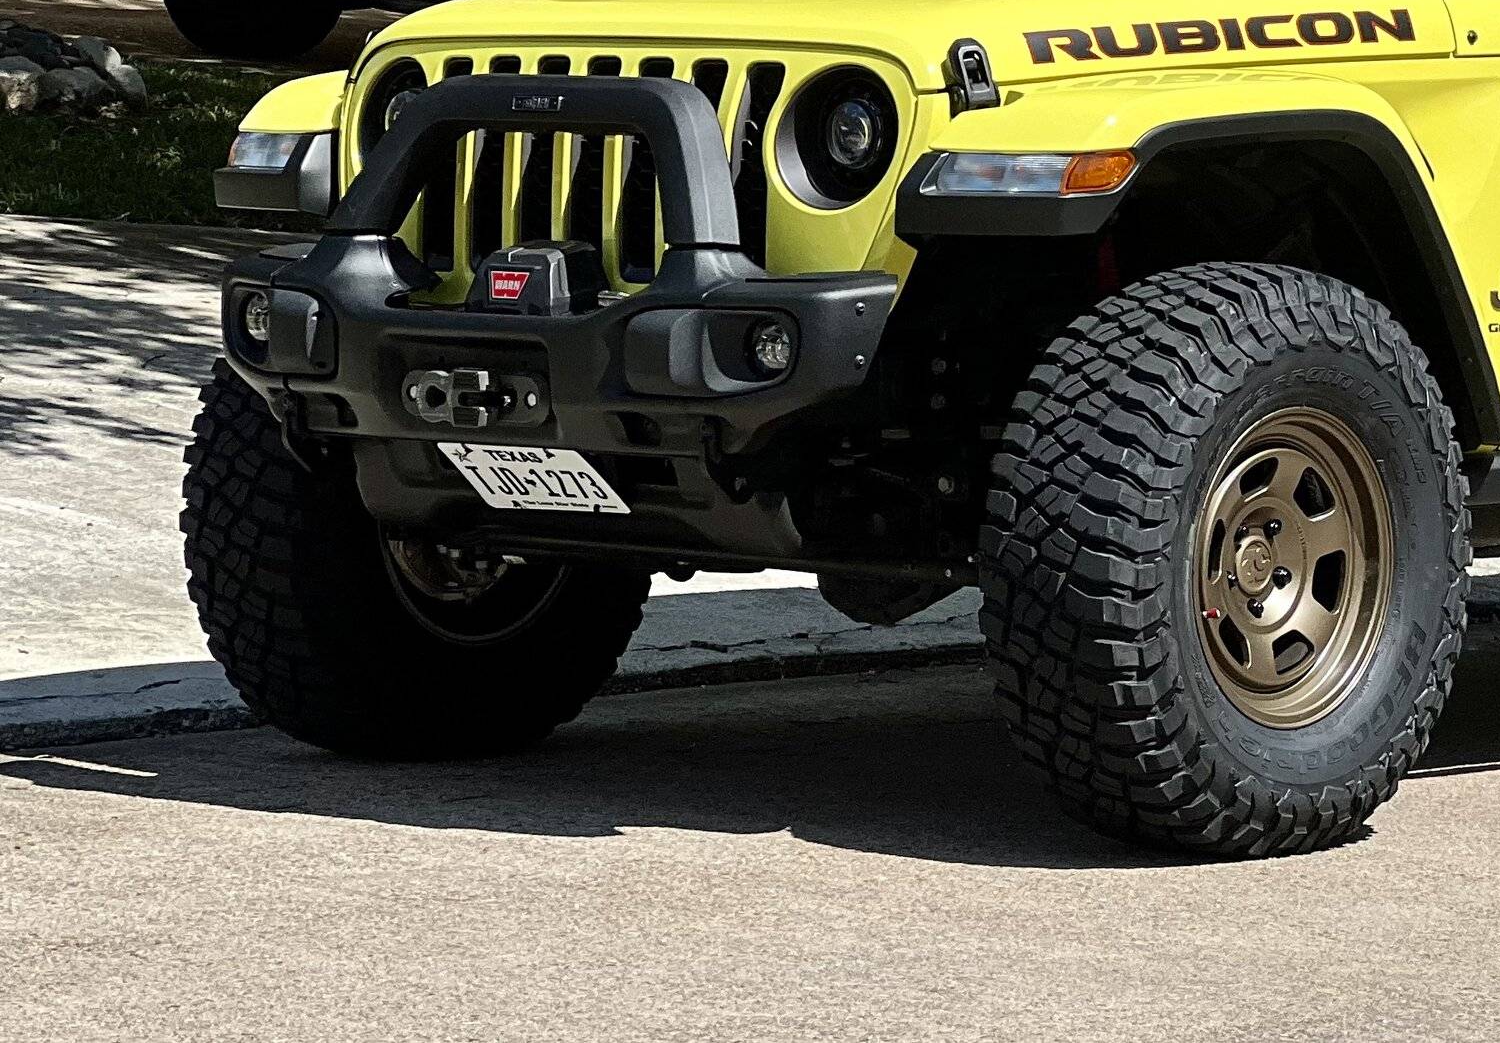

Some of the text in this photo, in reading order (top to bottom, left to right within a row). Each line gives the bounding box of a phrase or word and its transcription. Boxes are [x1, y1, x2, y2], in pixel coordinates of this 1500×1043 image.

[1022, 9, 1417, 65] RUBICON
[495, 280, 520, 290] WARN
[482, 449, 543, 464] TEXAS
